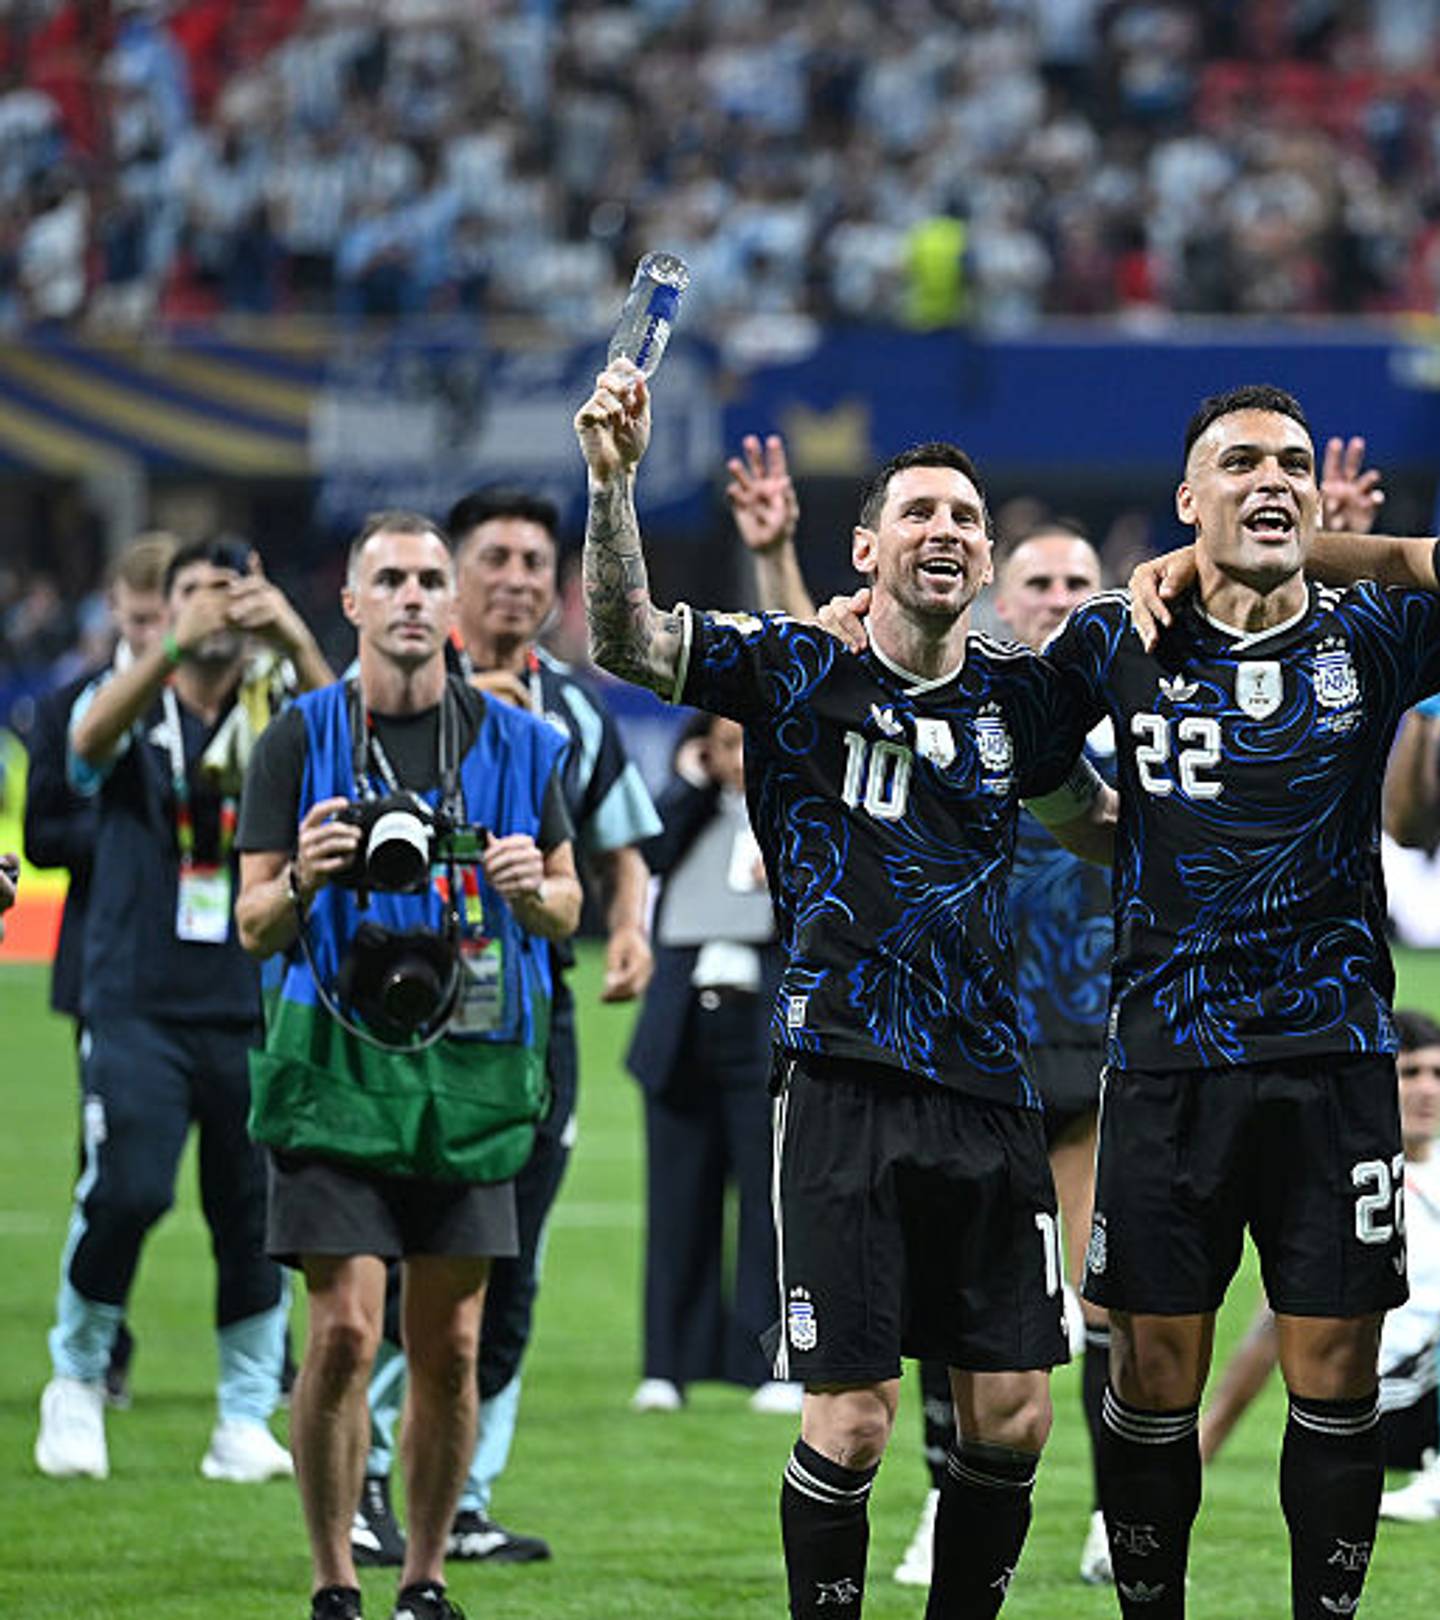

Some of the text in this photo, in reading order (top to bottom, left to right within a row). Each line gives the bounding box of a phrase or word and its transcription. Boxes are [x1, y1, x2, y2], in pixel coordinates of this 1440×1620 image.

[842, 730, 915, 822] 10
[1131, 711, 1236, 800] 22
[1034, 1211, 1060, 1298] 1
